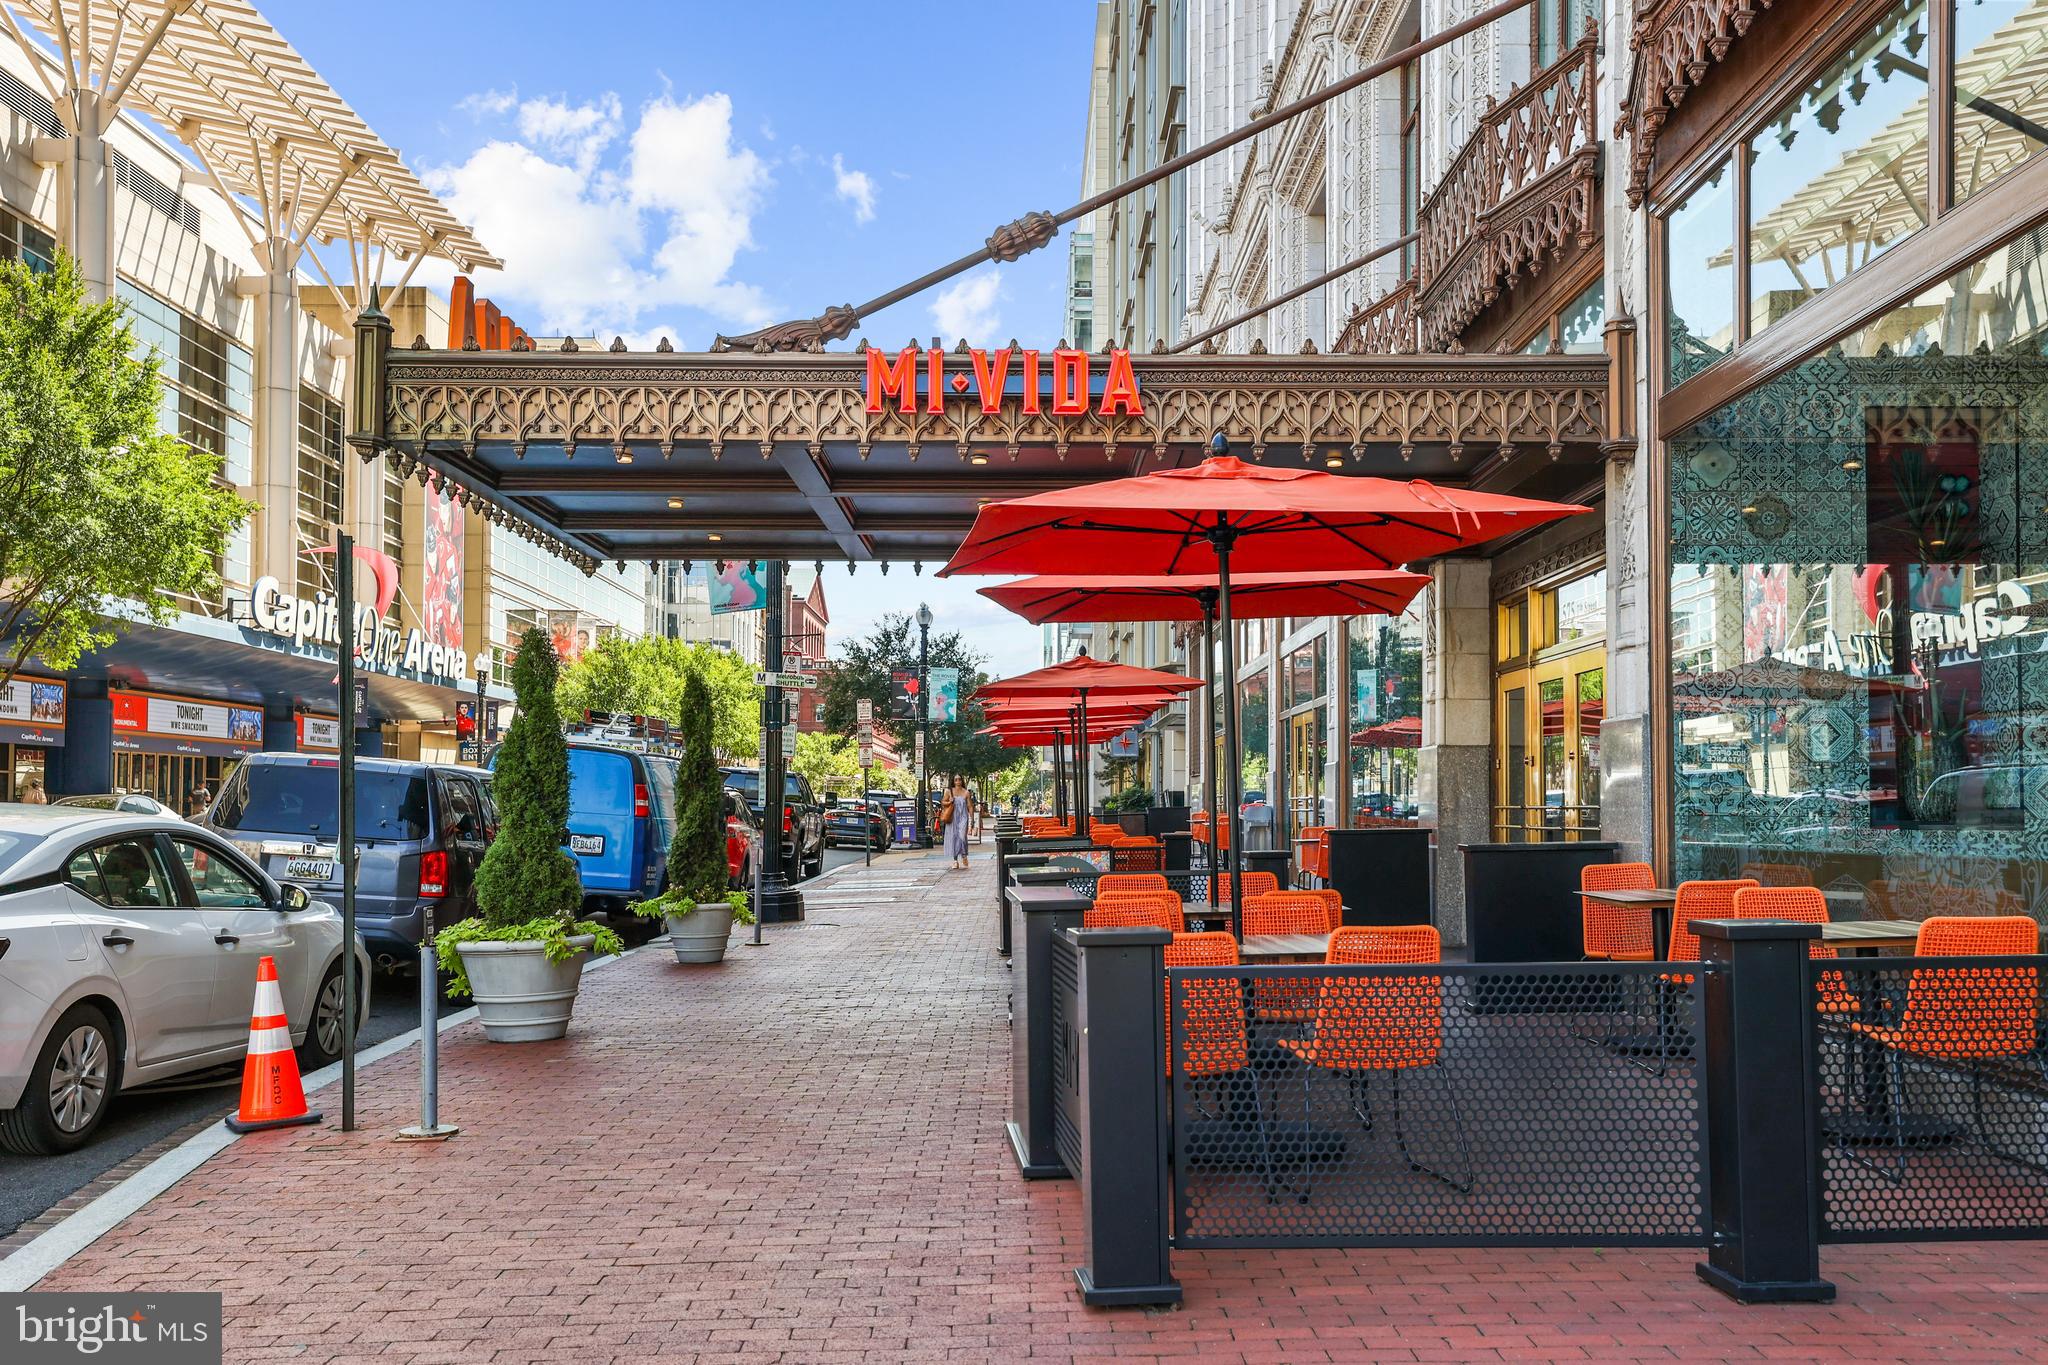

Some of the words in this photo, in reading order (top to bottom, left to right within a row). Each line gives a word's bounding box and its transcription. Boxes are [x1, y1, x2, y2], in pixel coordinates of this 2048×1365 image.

[866, 348, 944, 414] MI
[969, 349, 1144, 416] VIDA
[360, 606, 401, 668] One
[403, 628, 467, 680] Arena
[757, 673, 766, 681] M
[177, 705, 203, 720] TONIGHT
[181, 722, 208, 731] SMACKDOWN
